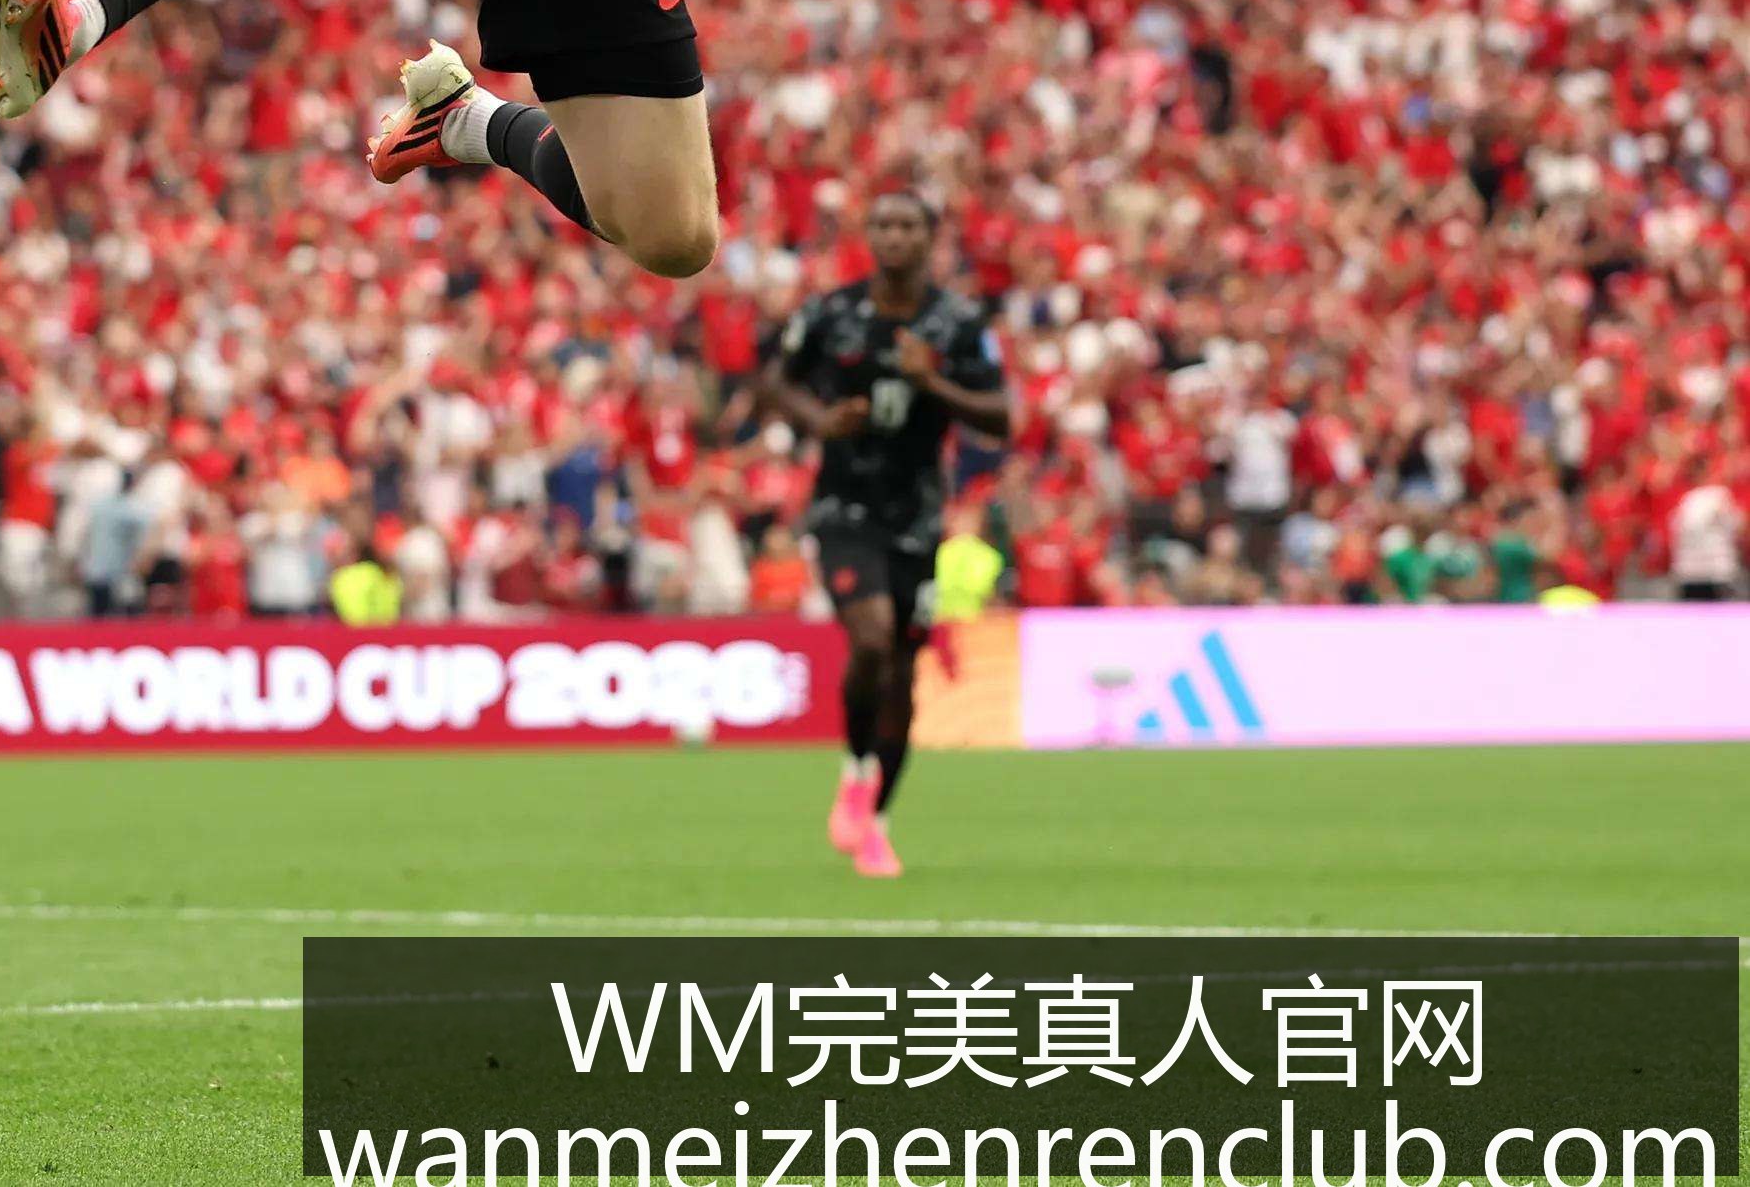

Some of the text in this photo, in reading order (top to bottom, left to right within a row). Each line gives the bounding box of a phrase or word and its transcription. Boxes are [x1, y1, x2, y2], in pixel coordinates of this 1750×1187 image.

[29, 646, 335, 732] WORLD
[336, 644, 505, 730] CUP
[506, 640, 788, 727] 2026
